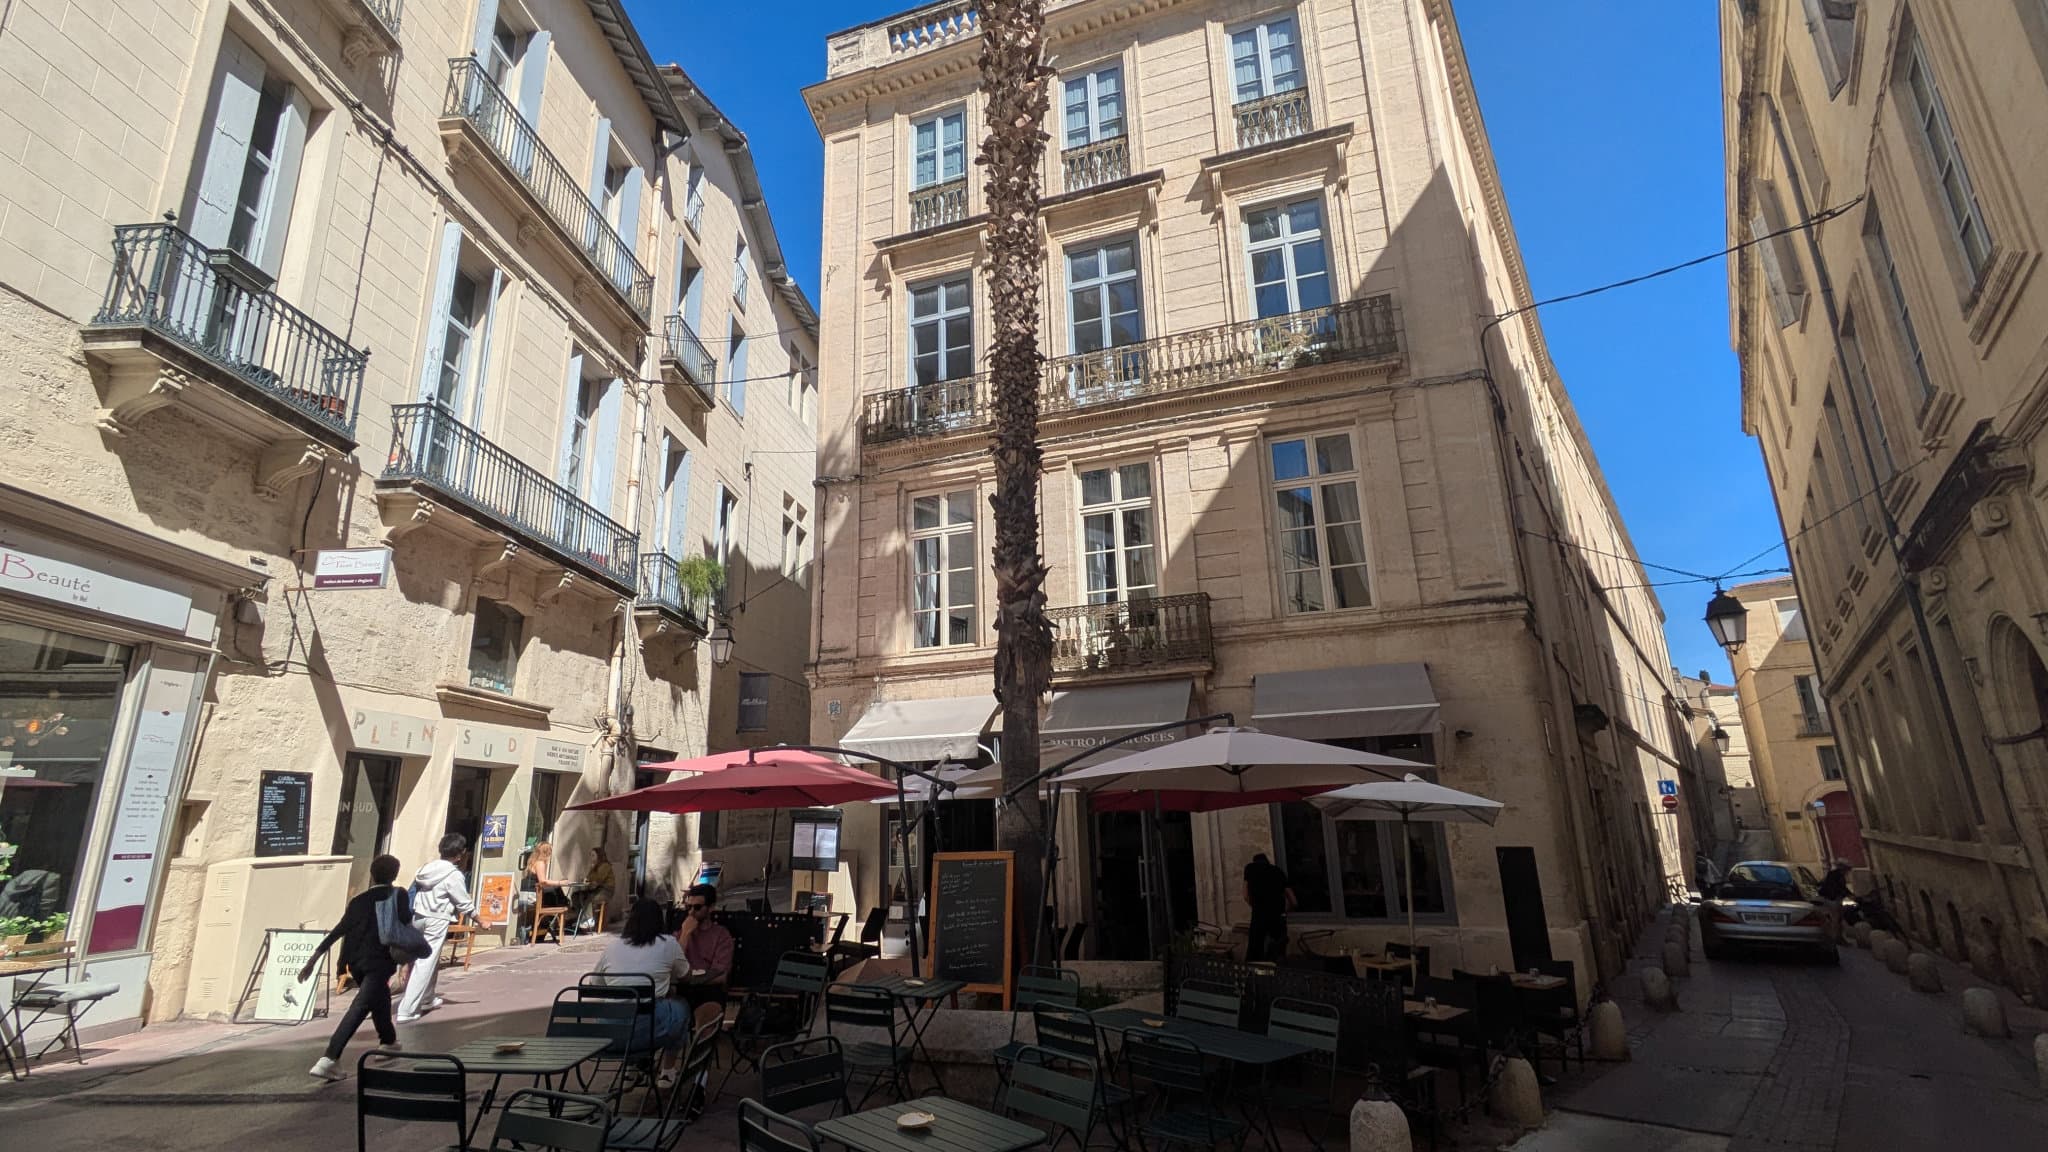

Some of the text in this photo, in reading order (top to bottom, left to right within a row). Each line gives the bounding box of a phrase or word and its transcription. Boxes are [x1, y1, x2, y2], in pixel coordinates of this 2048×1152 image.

[0, 553, 91, 593] Beauté
[353, 711, 435, 749] PLEIN
[463, 728, 517, 758] SUD
[283, 942, 314, 952] GOOD
[280, 967, 300, 976] HER
